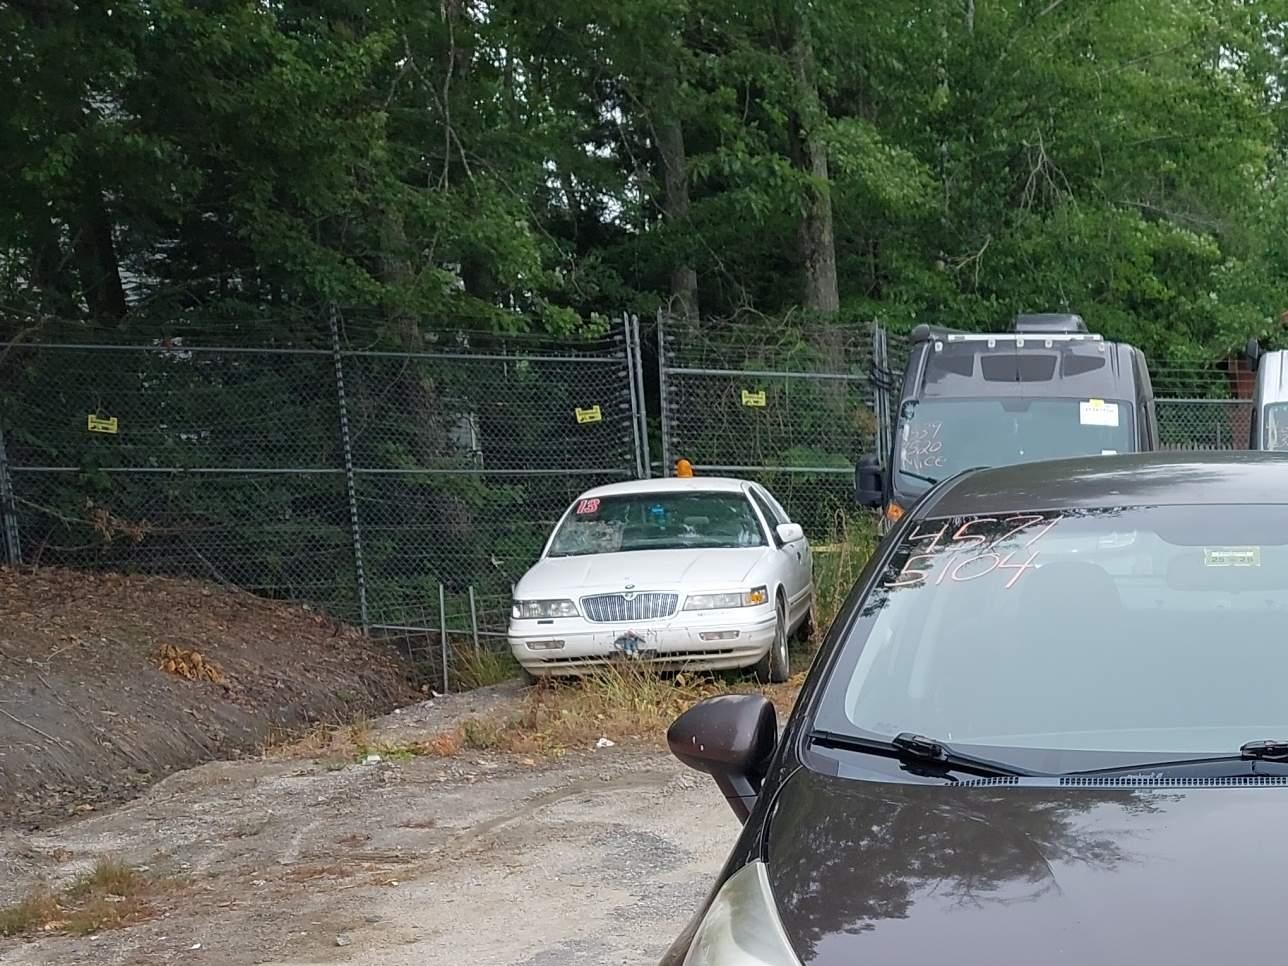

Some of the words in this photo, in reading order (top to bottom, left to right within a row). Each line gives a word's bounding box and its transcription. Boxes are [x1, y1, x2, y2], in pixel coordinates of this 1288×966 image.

[576, 499, 600, 514] 13
[909, 513, 1064, 554] 4571
[884, 550, 1040, 589] 5104
